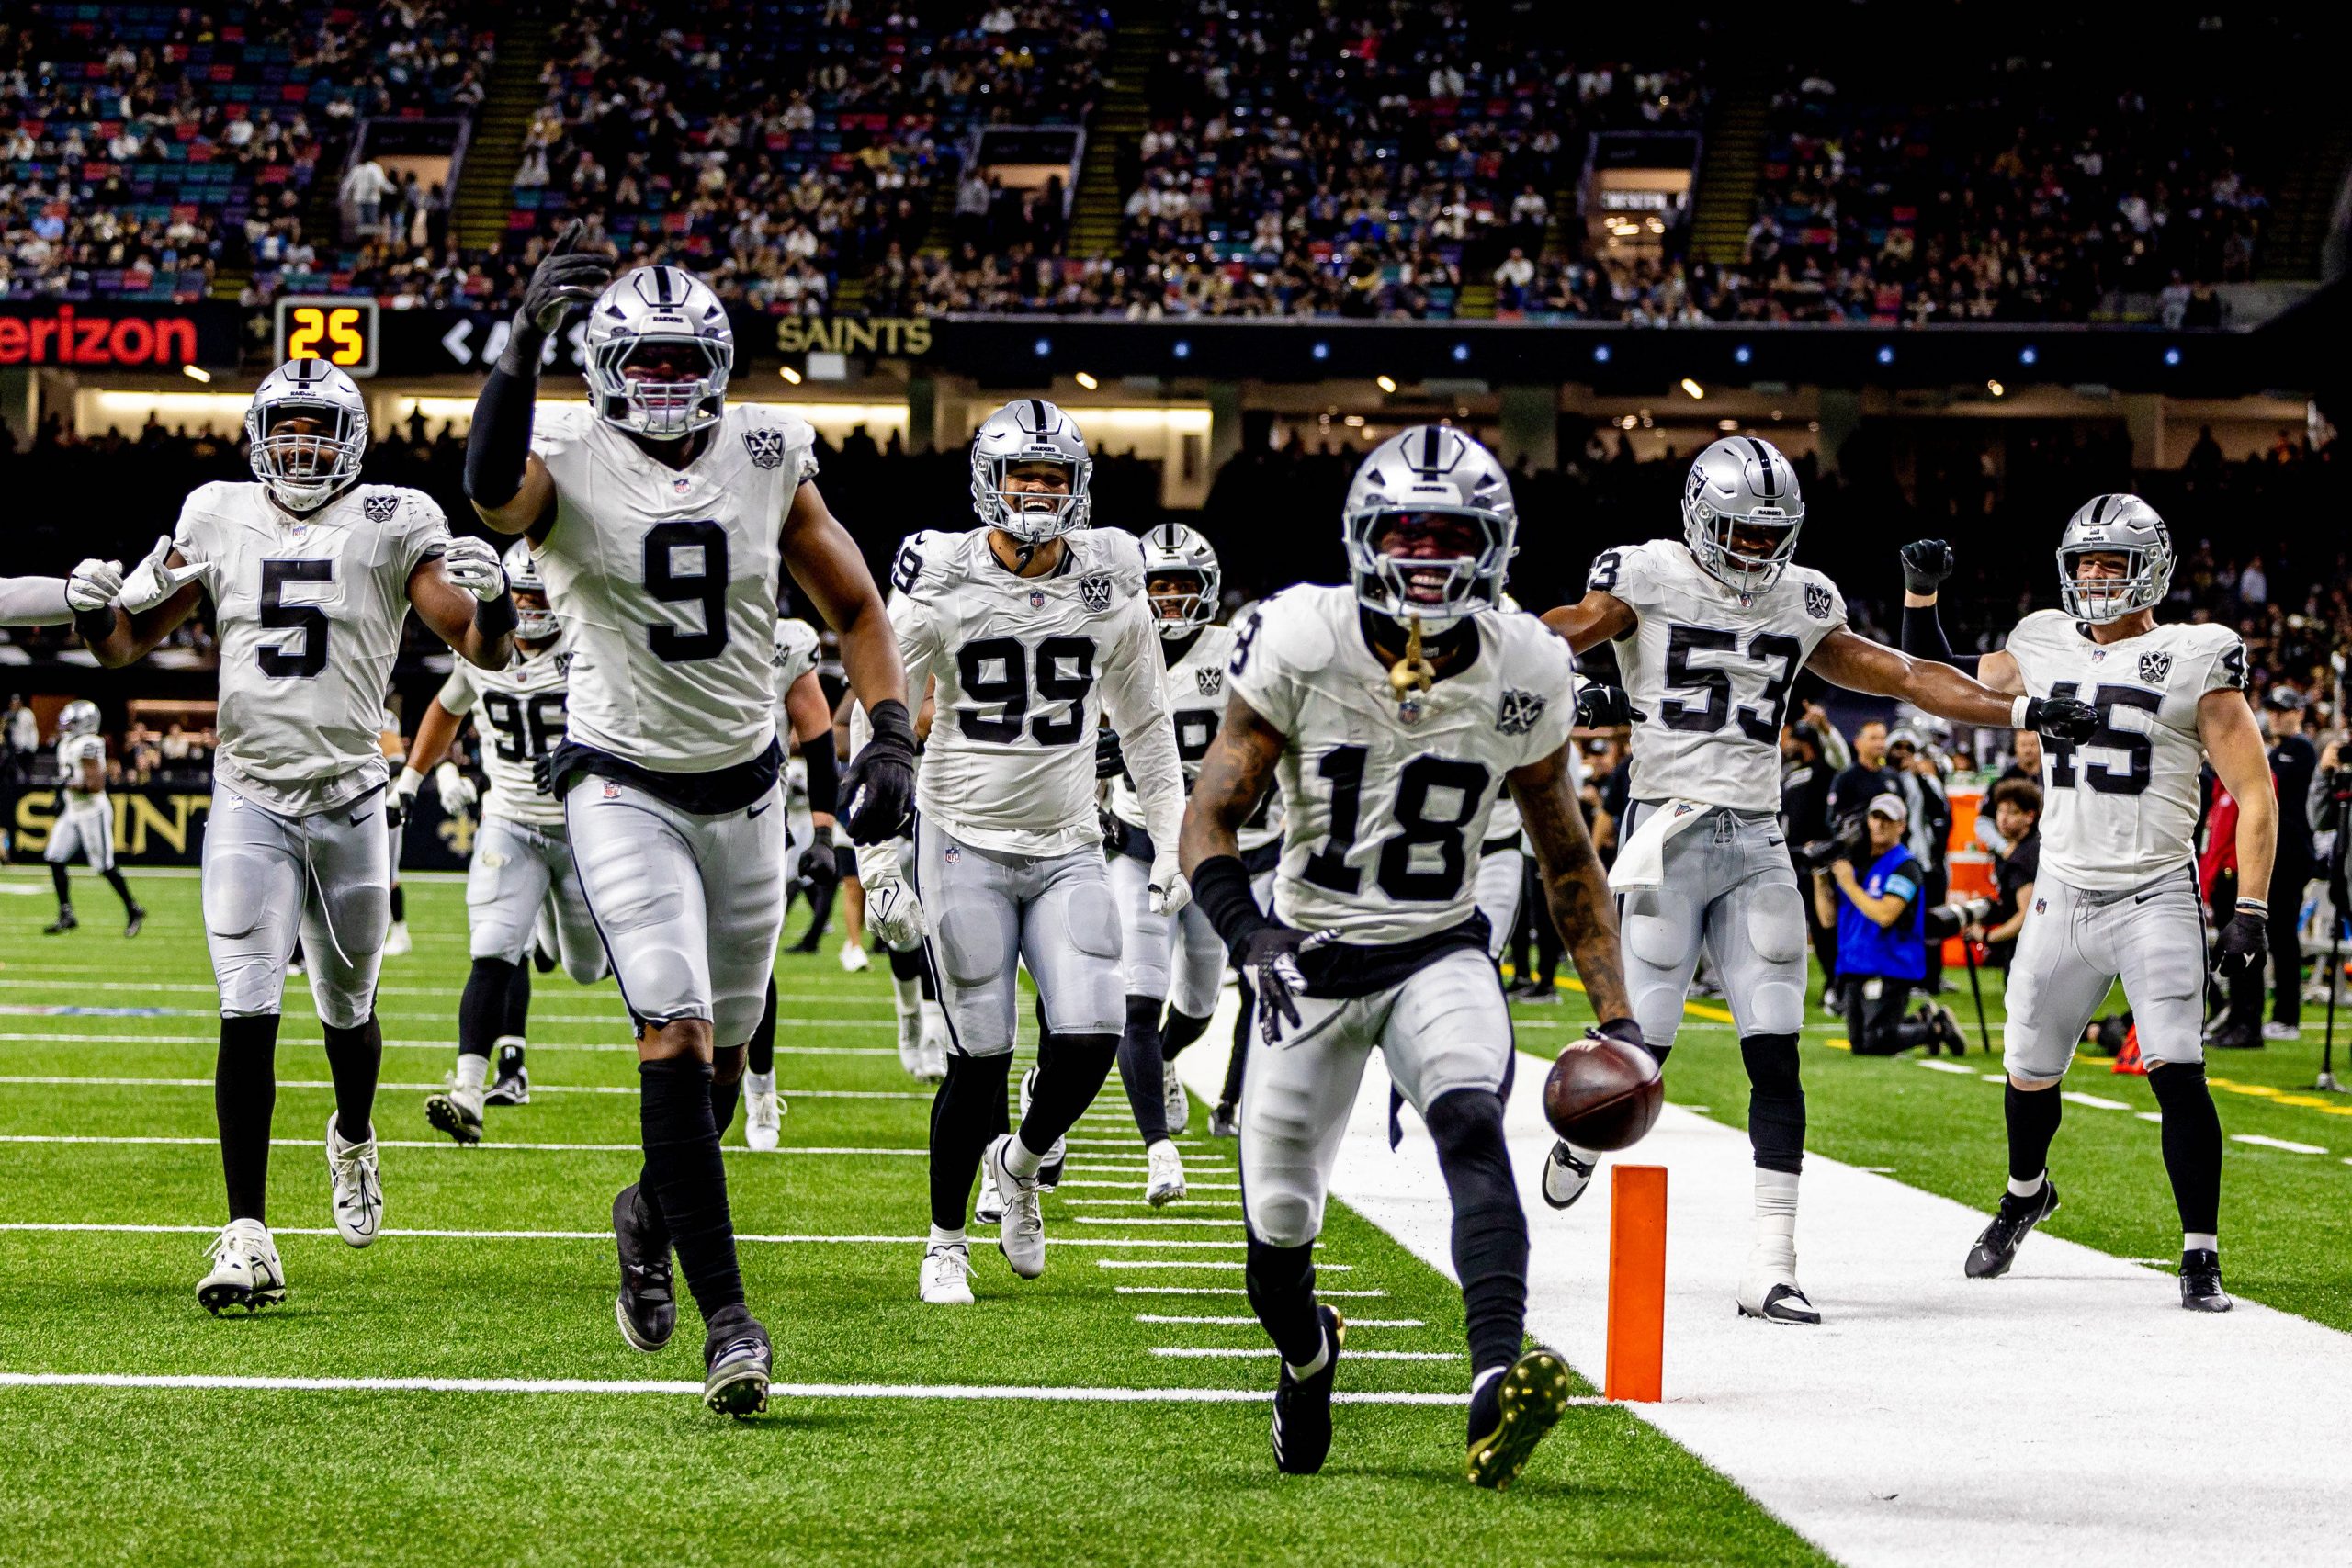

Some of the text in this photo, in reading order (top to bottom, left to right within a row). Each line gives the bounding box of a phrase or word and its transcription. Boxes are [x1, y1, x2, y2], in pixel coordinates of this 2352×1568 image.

[0, 304, 197, 365] erizon
[289, 308, 363, 366] 25
[777, 316, 932, 355] SAINTS
[368, 499, 395, 512] LXV
[256, 558, 334, 680] 5
[643, 520, 729, 660] 9
[1085, 582, 1110, 601] LXV
[956, 636, 1097, 746] 99
[1199, 672, 1220, 687] LXV
[1660, 625, 1803, 746] 53
[2142, 658, 2167, 673] LXV
[1302, 744, 1490, 901] 18
